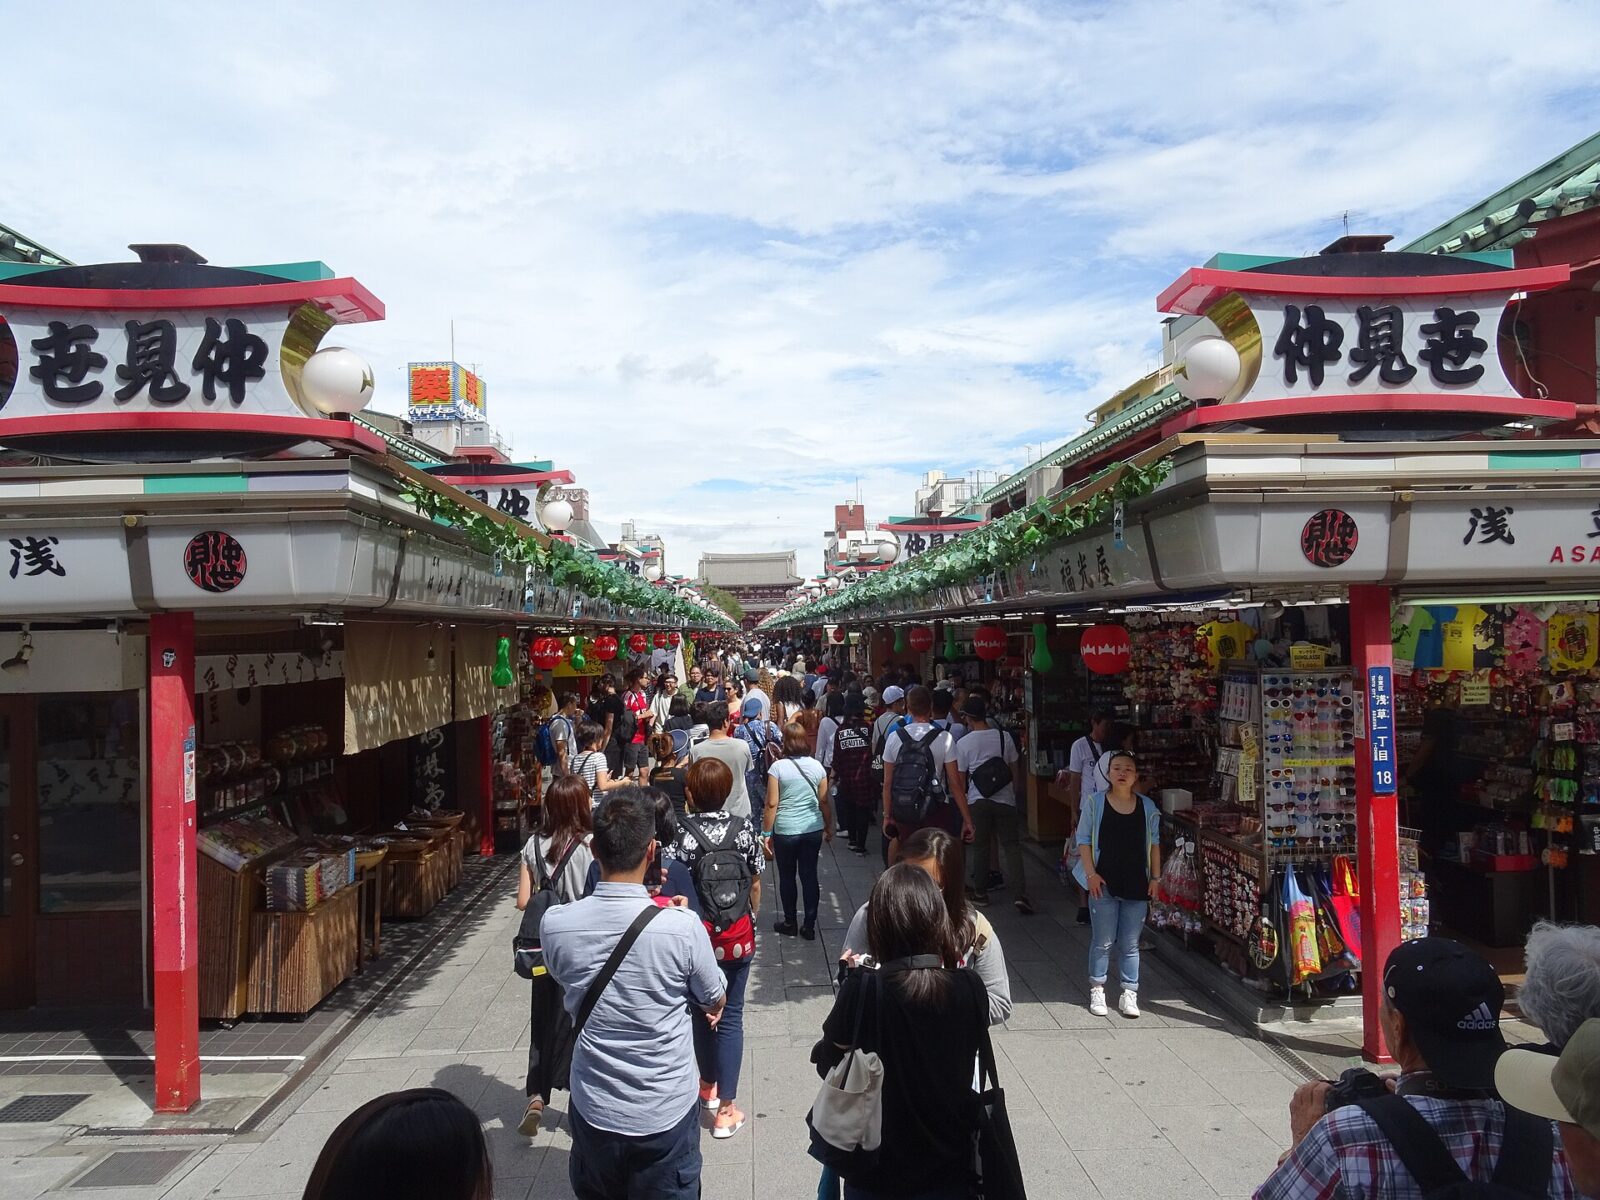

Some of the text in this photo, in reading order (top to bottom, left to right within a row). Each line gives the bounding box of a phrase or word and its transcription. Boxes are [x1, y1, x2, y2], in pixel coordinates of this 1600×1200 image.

[1274, 303, 1488, 387] 仲見世
[411, 367, 450, 404] 薬
[1376, 695, 1389, 761] 浅草一丁目
[1377, 771, 1392, 784] 18
[1457, 1020, 1497, 1030] adidas
